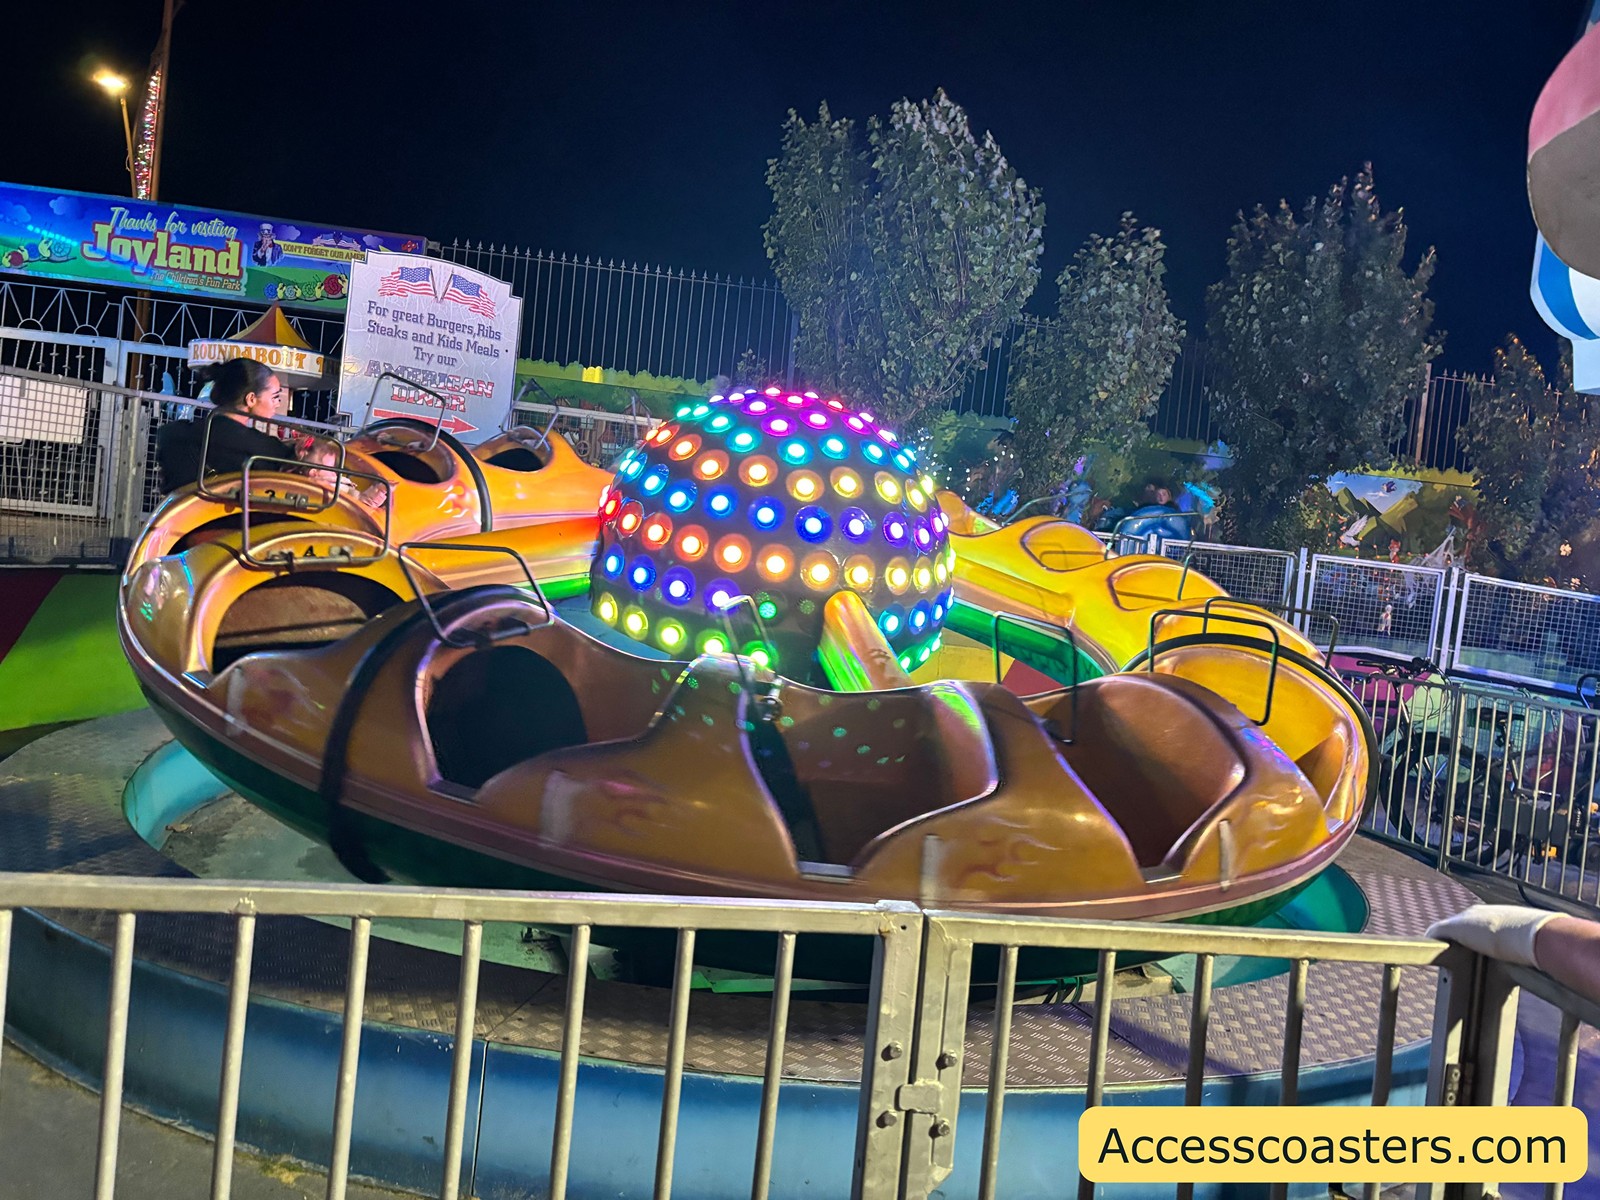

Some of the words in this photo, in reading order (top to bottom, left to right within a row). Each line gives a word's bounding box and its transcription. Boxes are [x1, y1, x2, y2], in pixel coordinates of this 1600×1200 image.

[110, 207, 158, 232] Thanks
[164, 211, 187, 234] for
[190, 218, 239, 241] visiting
[82, 222, 243, 278] Joyland
[283, 243, 301, 253] DON'T
[303, 246, 329, 257] FORGET
[329, 250, 344, 259] OUR
[150, 271, 165, 281] The
[166, 272, 204, 286] Children's
[205, 277, 220, 288] Fun
[221, 279, 241, 291] Park
[367, 300, 389, 316] For
[392, 309, 424, 323] great
[367, 320, 408, 341] Steaks
[411, 331, 434, 346] and
[436, 335, 463, 352] Kids
[465, 340, 500, 359] Meals
[193, 344, 307, 369] ROUNDABOUT
[413, 346, 434, 364] Try
[437, 355, 457, 367] our
[364, 359, 495, 398] AMERICAN
[391, 384, 466, 412] DINER
